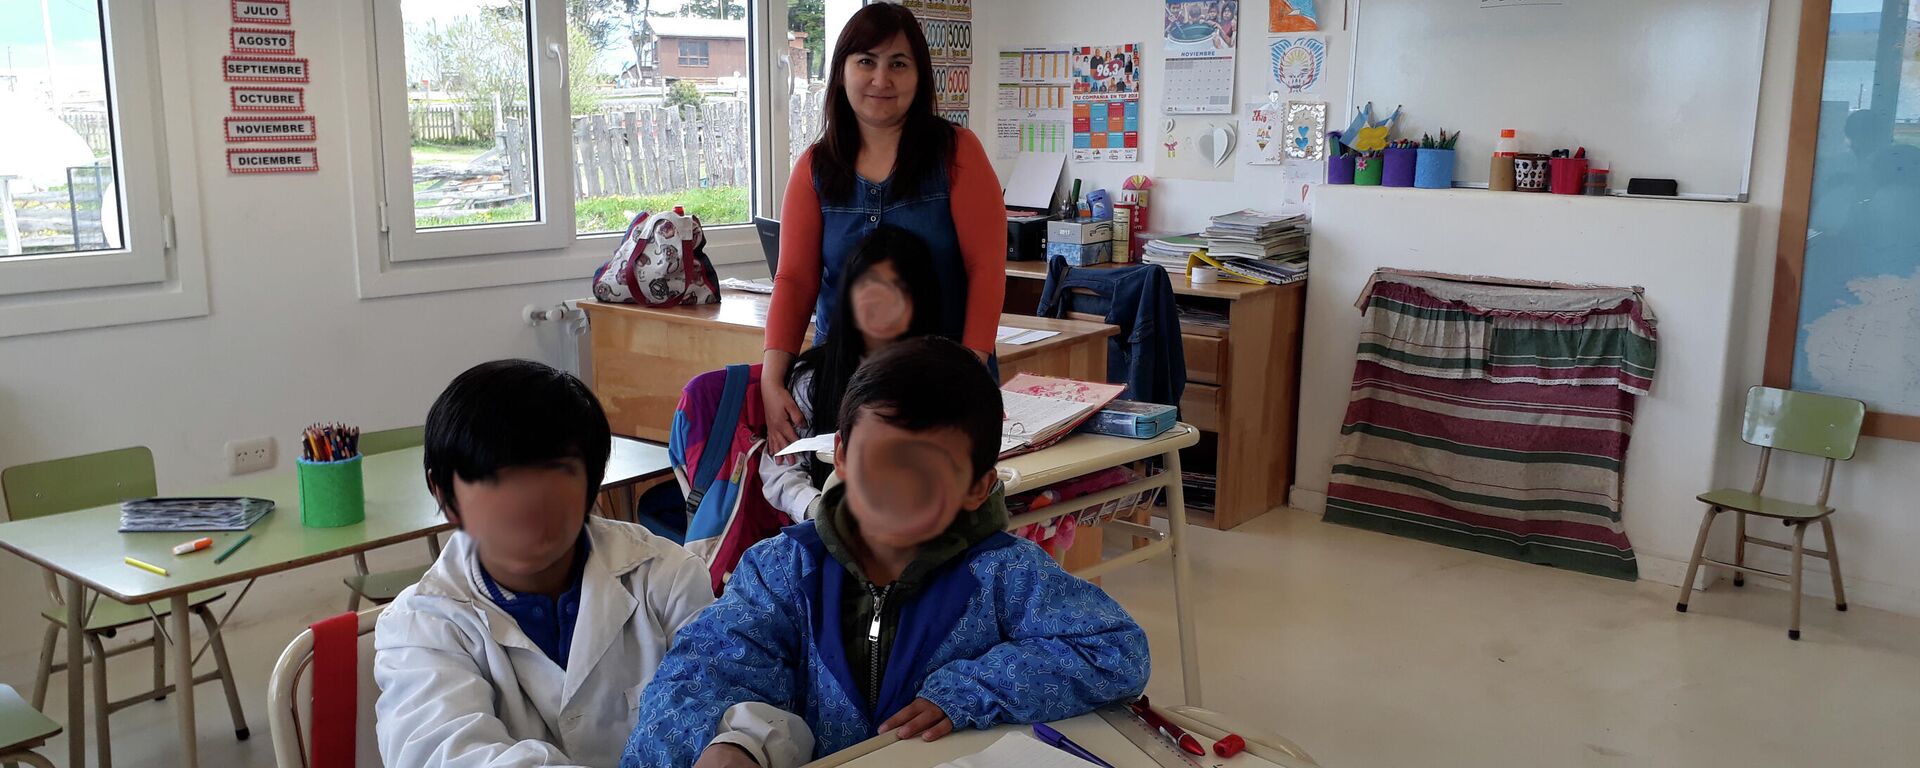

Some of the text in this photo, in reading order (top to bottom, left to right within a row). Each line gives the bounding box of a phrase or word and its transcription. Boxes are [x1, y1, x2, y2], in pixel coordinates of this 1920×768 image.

[243, 6, 278, 16] JULIO
[238, 36, 287, 47] AGOSTO
[948, 23, 971, 49] 3000
[228, 64, 302, 75] SEPTIEMBRE
[1096, 63, 1119, 77] 96.3
[948, 69, 969, 93] 6000
[240, 94, 295, 104] OCTUBRE
[236, 124, 305, 134] NOVIEMBRE
[239, 156, 302, 165] DICIEMBRE
